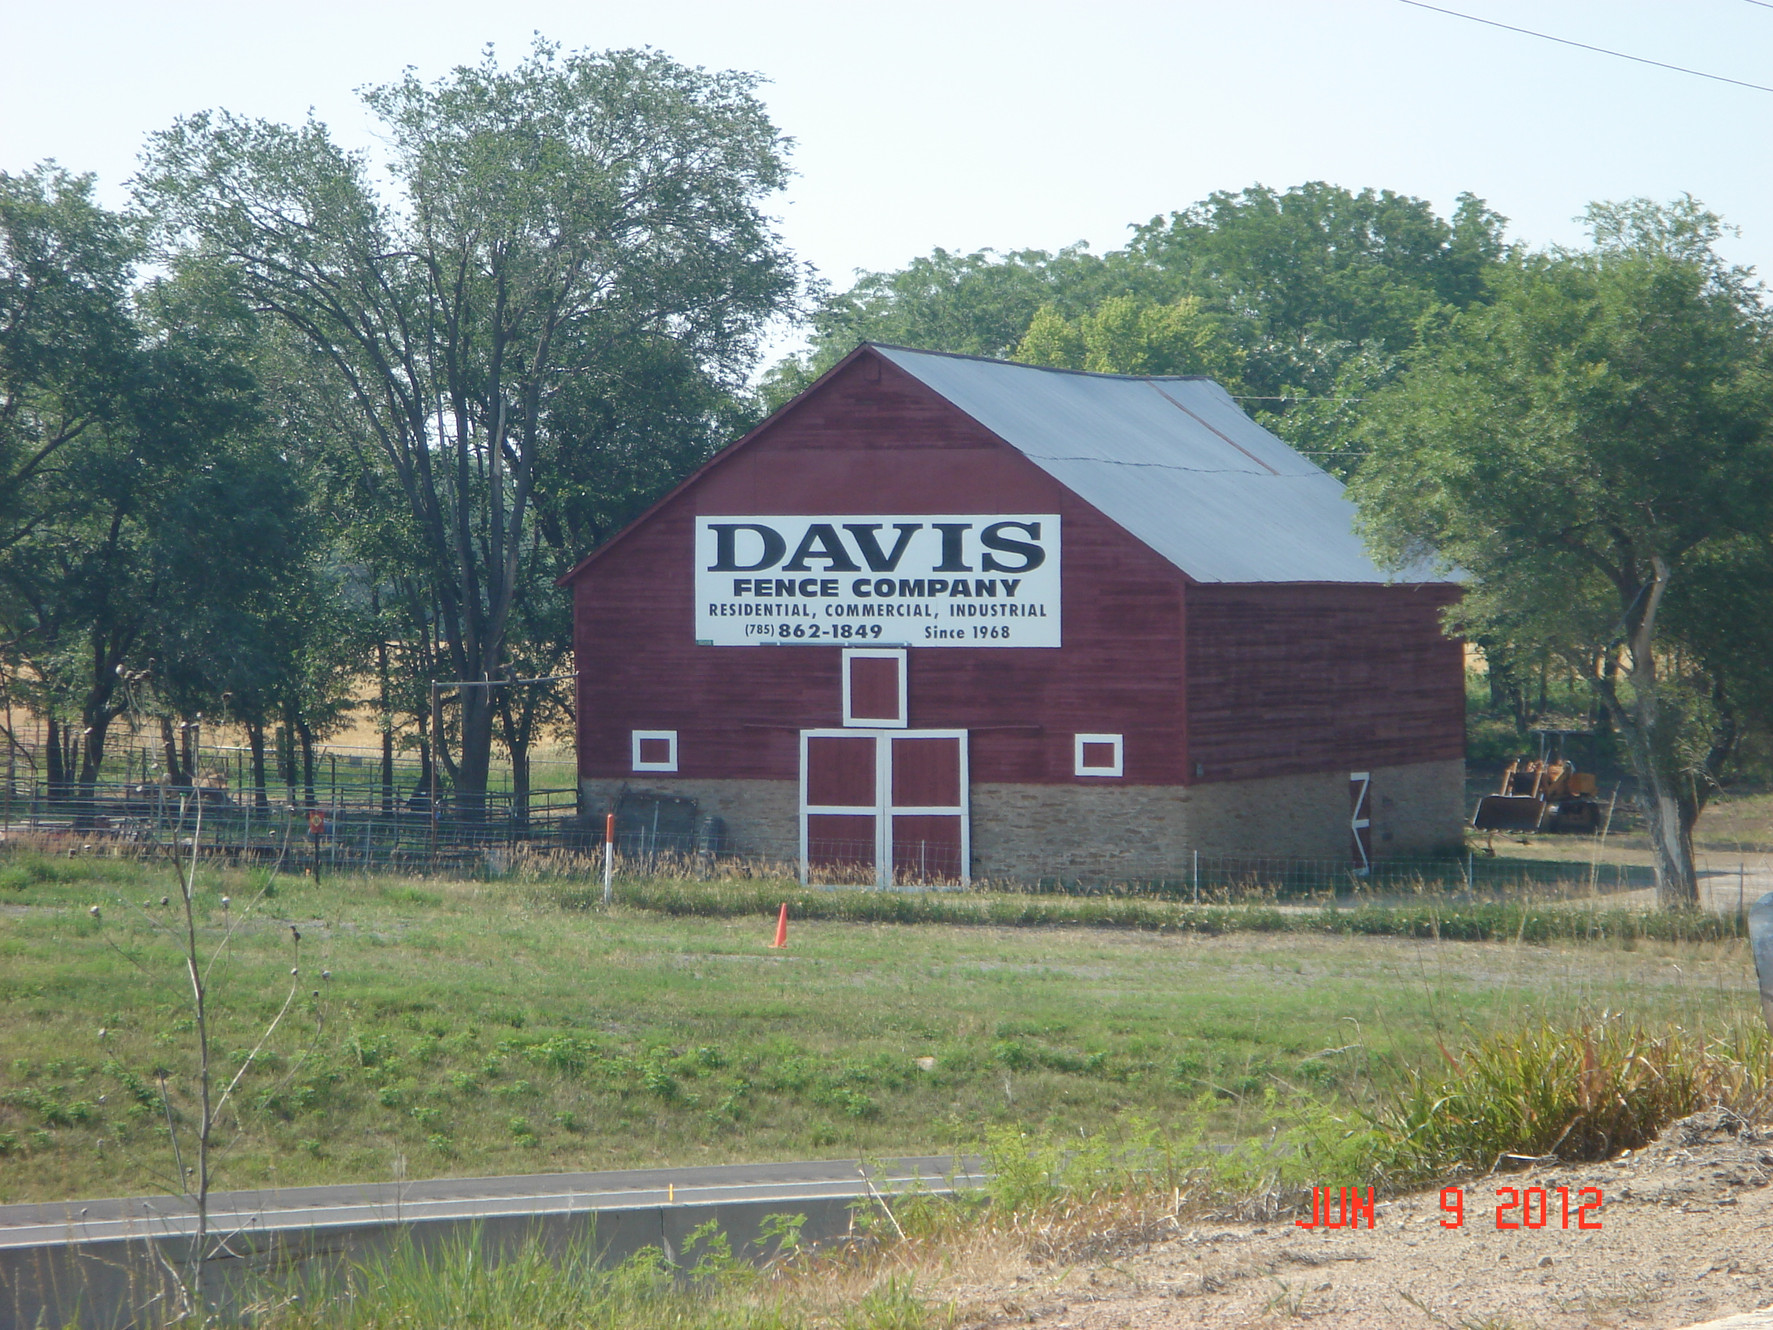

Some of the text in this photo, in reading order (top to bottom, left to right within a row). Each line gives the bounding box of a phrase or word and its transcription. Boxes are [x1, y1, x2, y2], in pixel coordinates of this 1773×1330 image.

[707, 521, 1045, 573] DAVIS
[733, 578, 1021, 597] FENCE COMPANY
[709, 603, 1047, 619] RESIDENTIAL, COMMERCIAL, INDUSTRIAL
[744, 624, 882, 639] (785) 862-1849
[924, 625, 1010, 639] Since 1968
